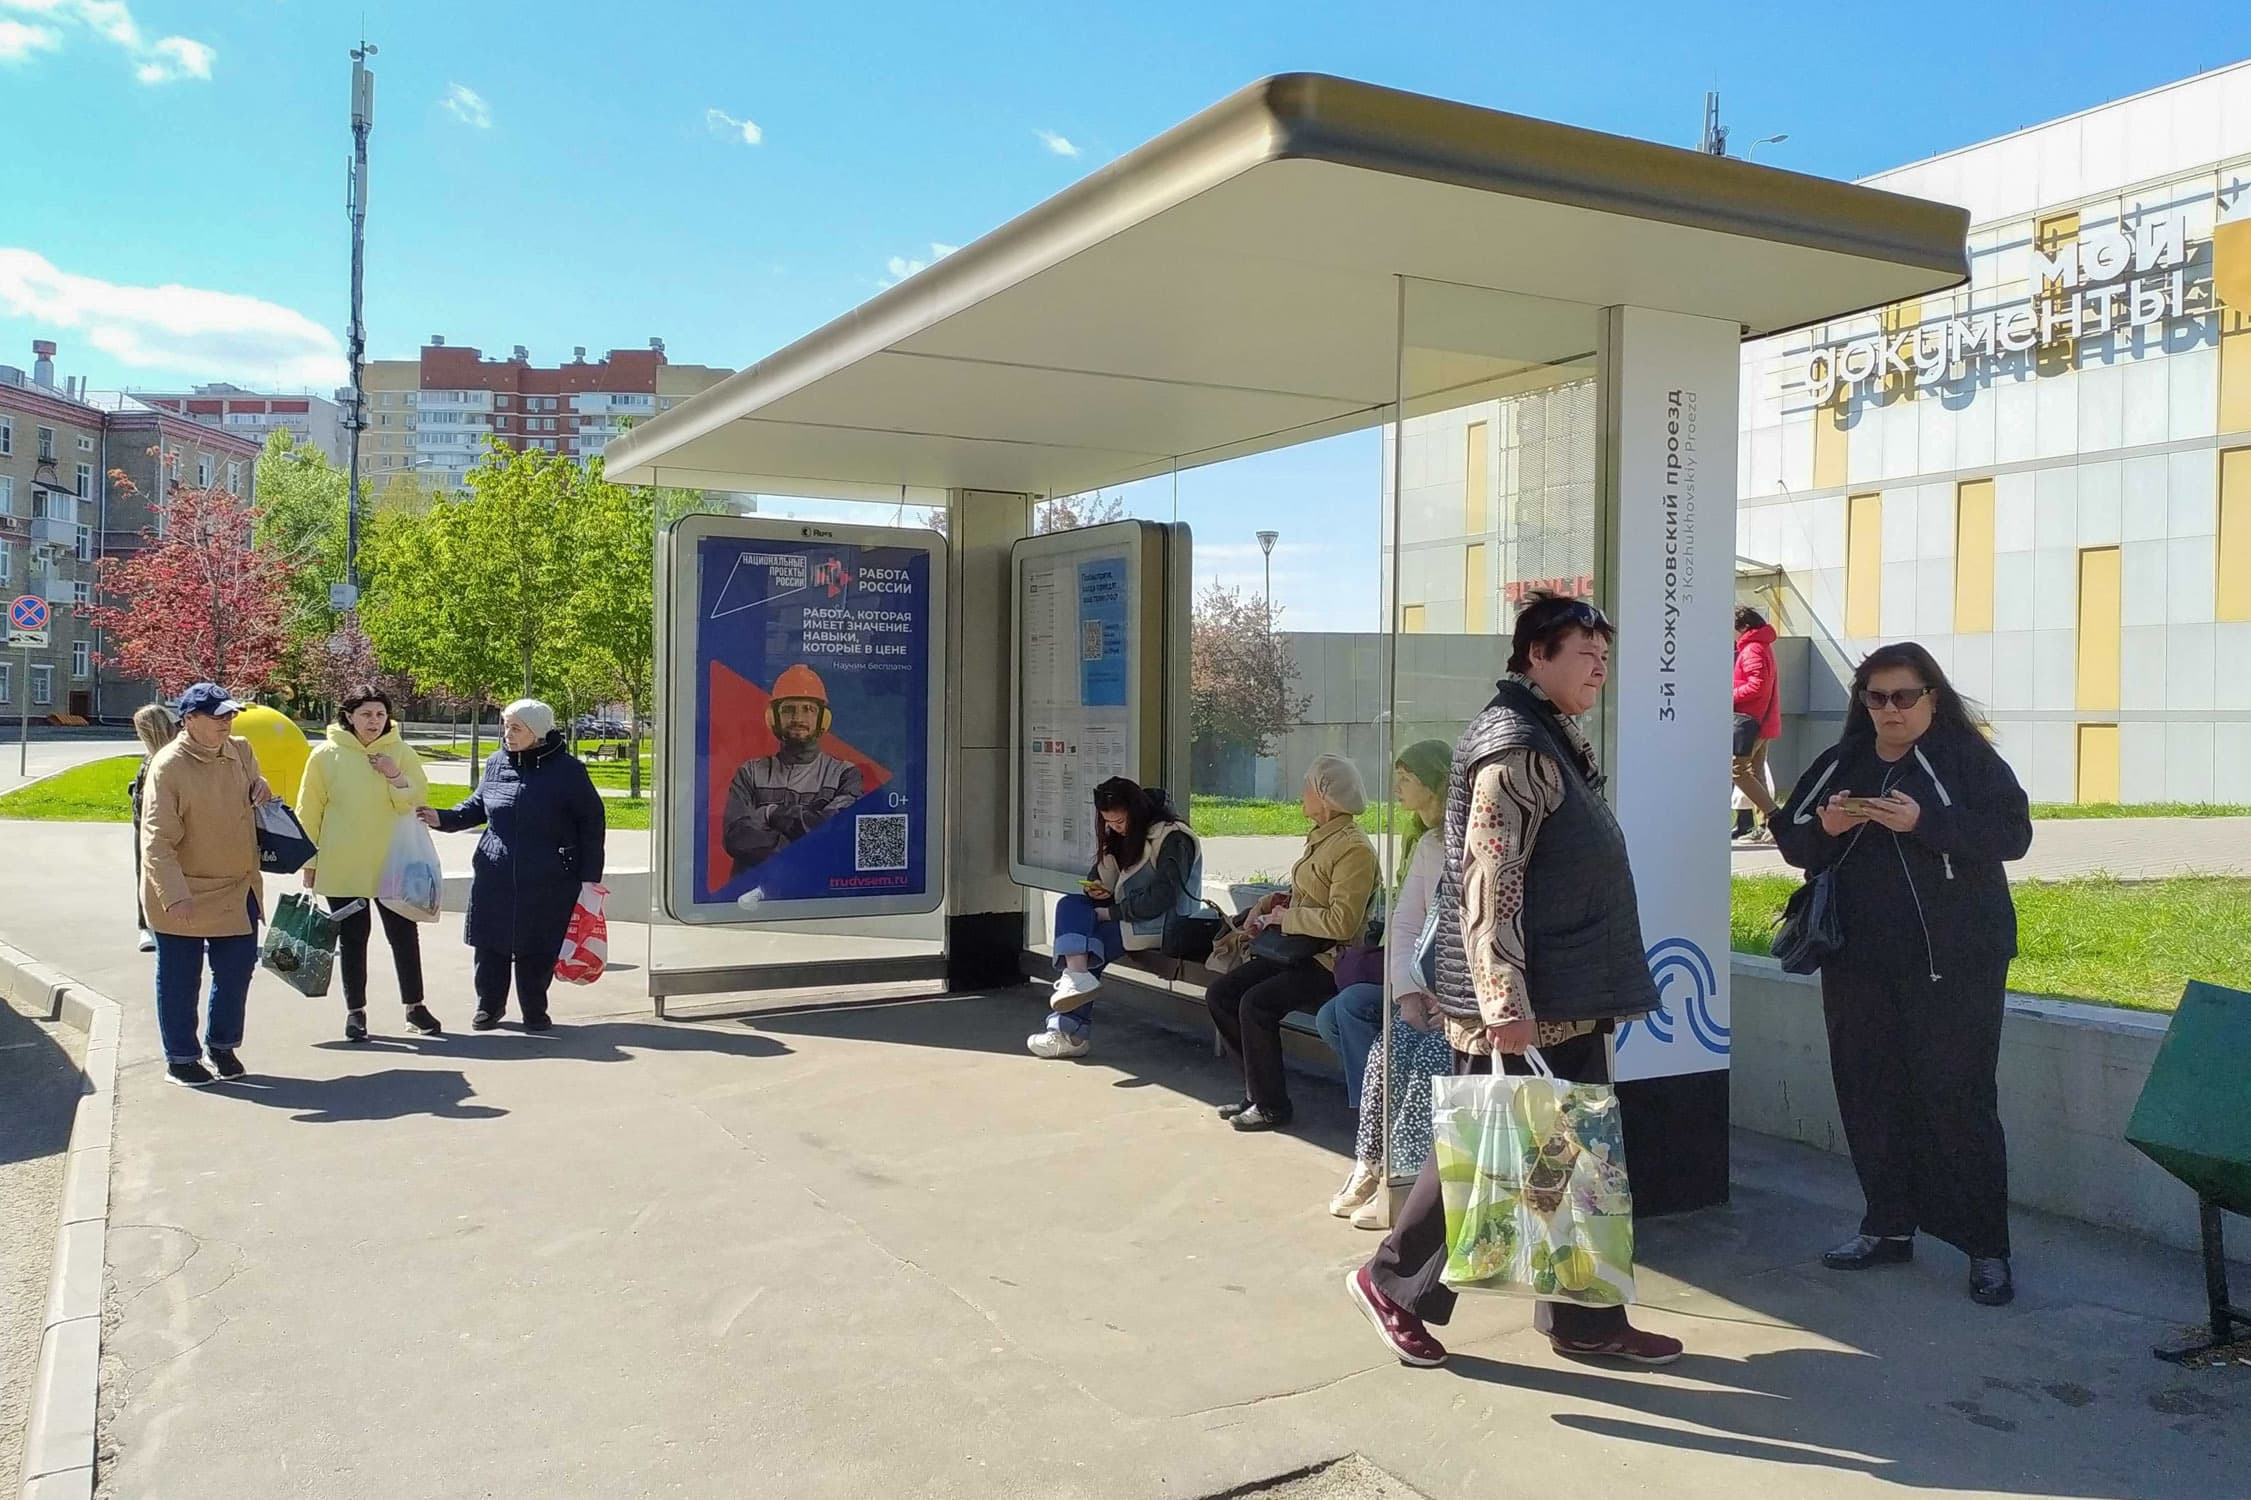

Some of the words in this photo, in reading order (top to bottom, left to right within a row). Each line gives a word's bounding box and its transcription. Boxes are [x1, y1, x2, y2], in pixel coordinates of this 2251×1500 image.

[1805, 270, 2184, 405] документы
[1684, 391, 1698, 452] Proezd
[1666, 389, 1682, 486] проезд
[1682, 458, 1697, 590] Kozhukhovskiy
[742, 555, 805, 567] НАЦИОНАЛЬНЫЕ
[769, 566, 805, 577] ПРОЕКТЫ
[859, 568, 910, 581] РАБОТА
[775, 576, 805, 587] РОССИИ
[859, 581, 912, 594] РОССИИ
[1660, 494, 1681, 673] Кожуховский
[1682, 593, 1693, 604] 3
[803, 608, 855, 621] РАБОТА,
[857, 610, 912, 621] КОТОРАЯ
[803, 620, 845, 631] ИМЕЕТ
[847, 621, 913, 633] ЗНАЧЕНИЕ.
[803, 631, 860, 644] НАВЫКИ,
[802, 643, 862, 655] КОТОРЫЕ
[864, 645, 873, 655] В
[875, 645, 907, 656] ЦЕНЕ
[832, 661, 866, 671] Научим
[868, 661, 912, 671] бесплатно
[1659, 684, 1675, 721] 3-й
[888, 792, 909, 808] 0+
[830, 876, 908, 887] trudvsem.ru
